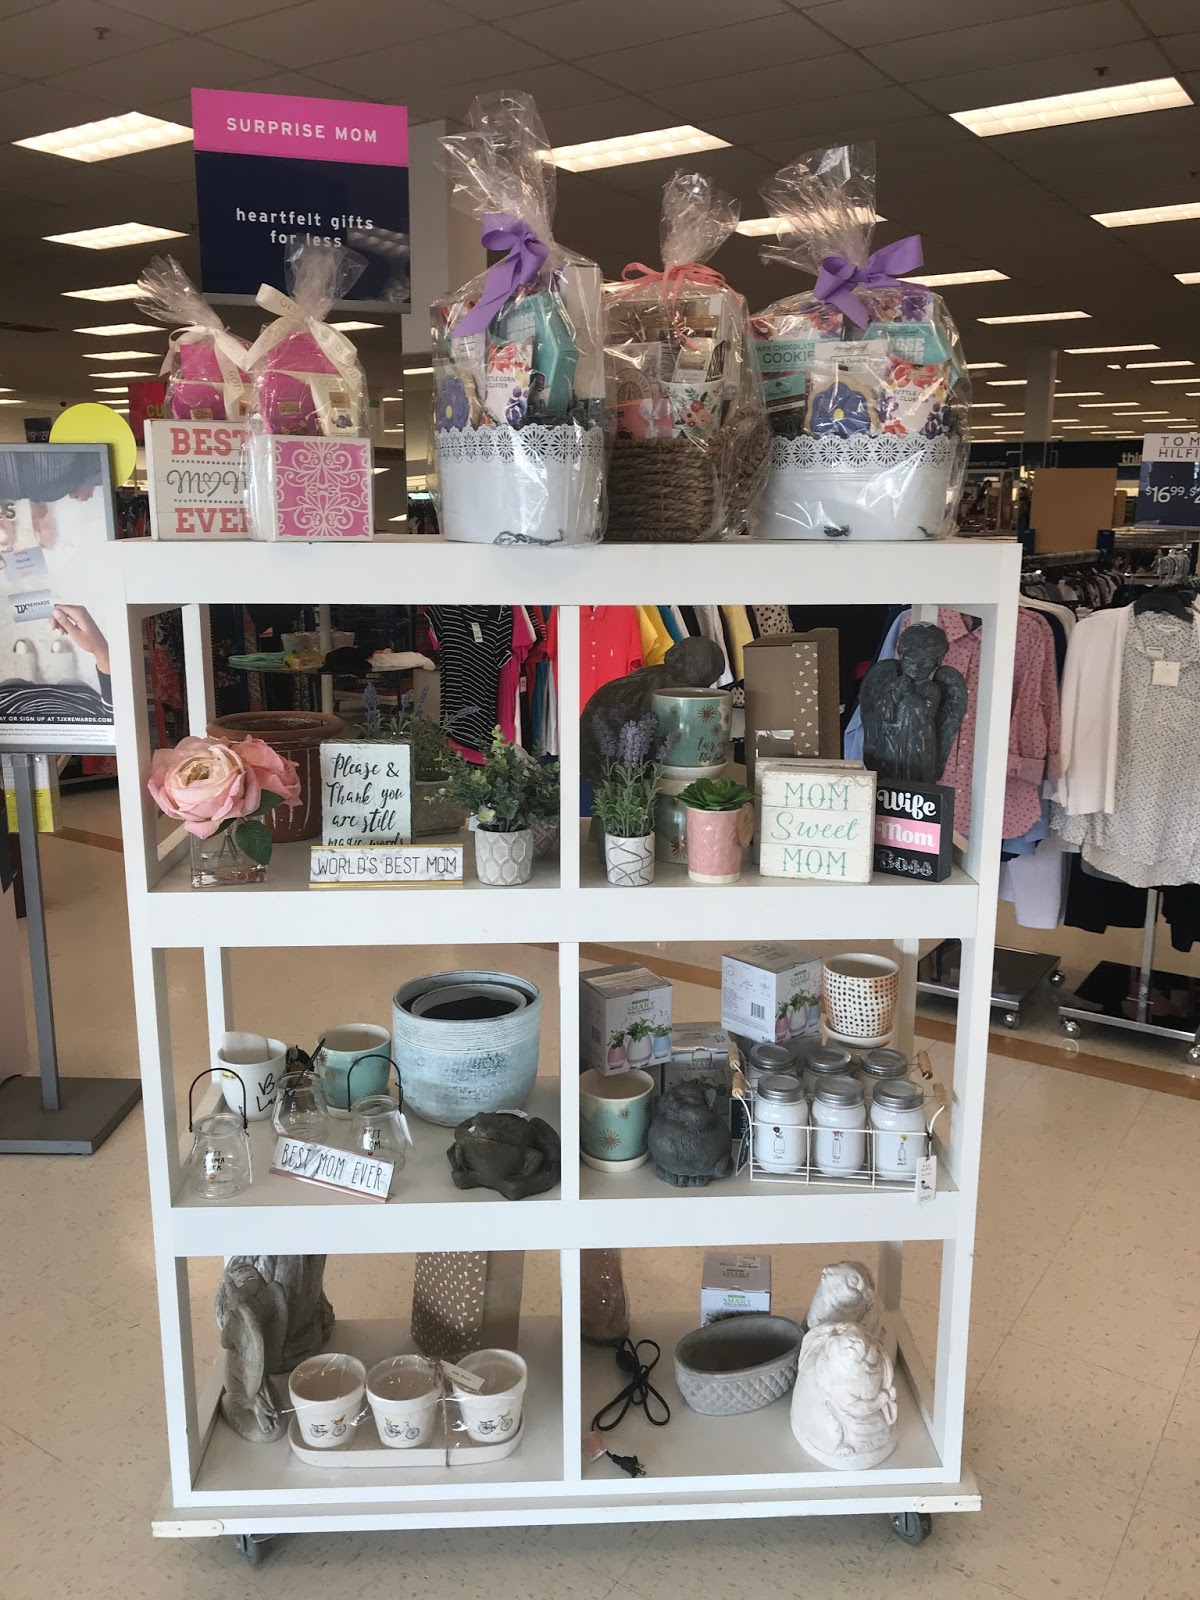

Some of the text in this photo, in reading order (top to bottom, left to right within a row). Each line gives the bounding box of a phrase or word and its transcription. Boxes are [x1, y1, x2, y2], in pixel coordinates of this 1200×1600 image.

[226, 117, 377, 143] SURPRISE MOM
[235, 207, 374, 230] heartfelt gifts
[270, 230, 343, 248] for less
[773, 343, 816, 351] CHOCOLATE
[170, 427, 250, 457] BEST
[330, 752, 400, 780] Please &
[326, 781, 405, 809] Thank you
[783, 782, 849, 811] MOM
[876, 789, 937, 820] Wife
[332, 808, 397, 833] are still
[770, 811, 860, 841] Sweet
[876, 821, 936, 848] Mom
[316, 855, 457, 876] WORLD'S BEST MOM
[782, 848, 847, 877] MOM
[876, 849, 934, 878] Boss
[626, 1001, 656, 1012] SMART
[281, 1143, 383, 1191] BEST MOM EVER
